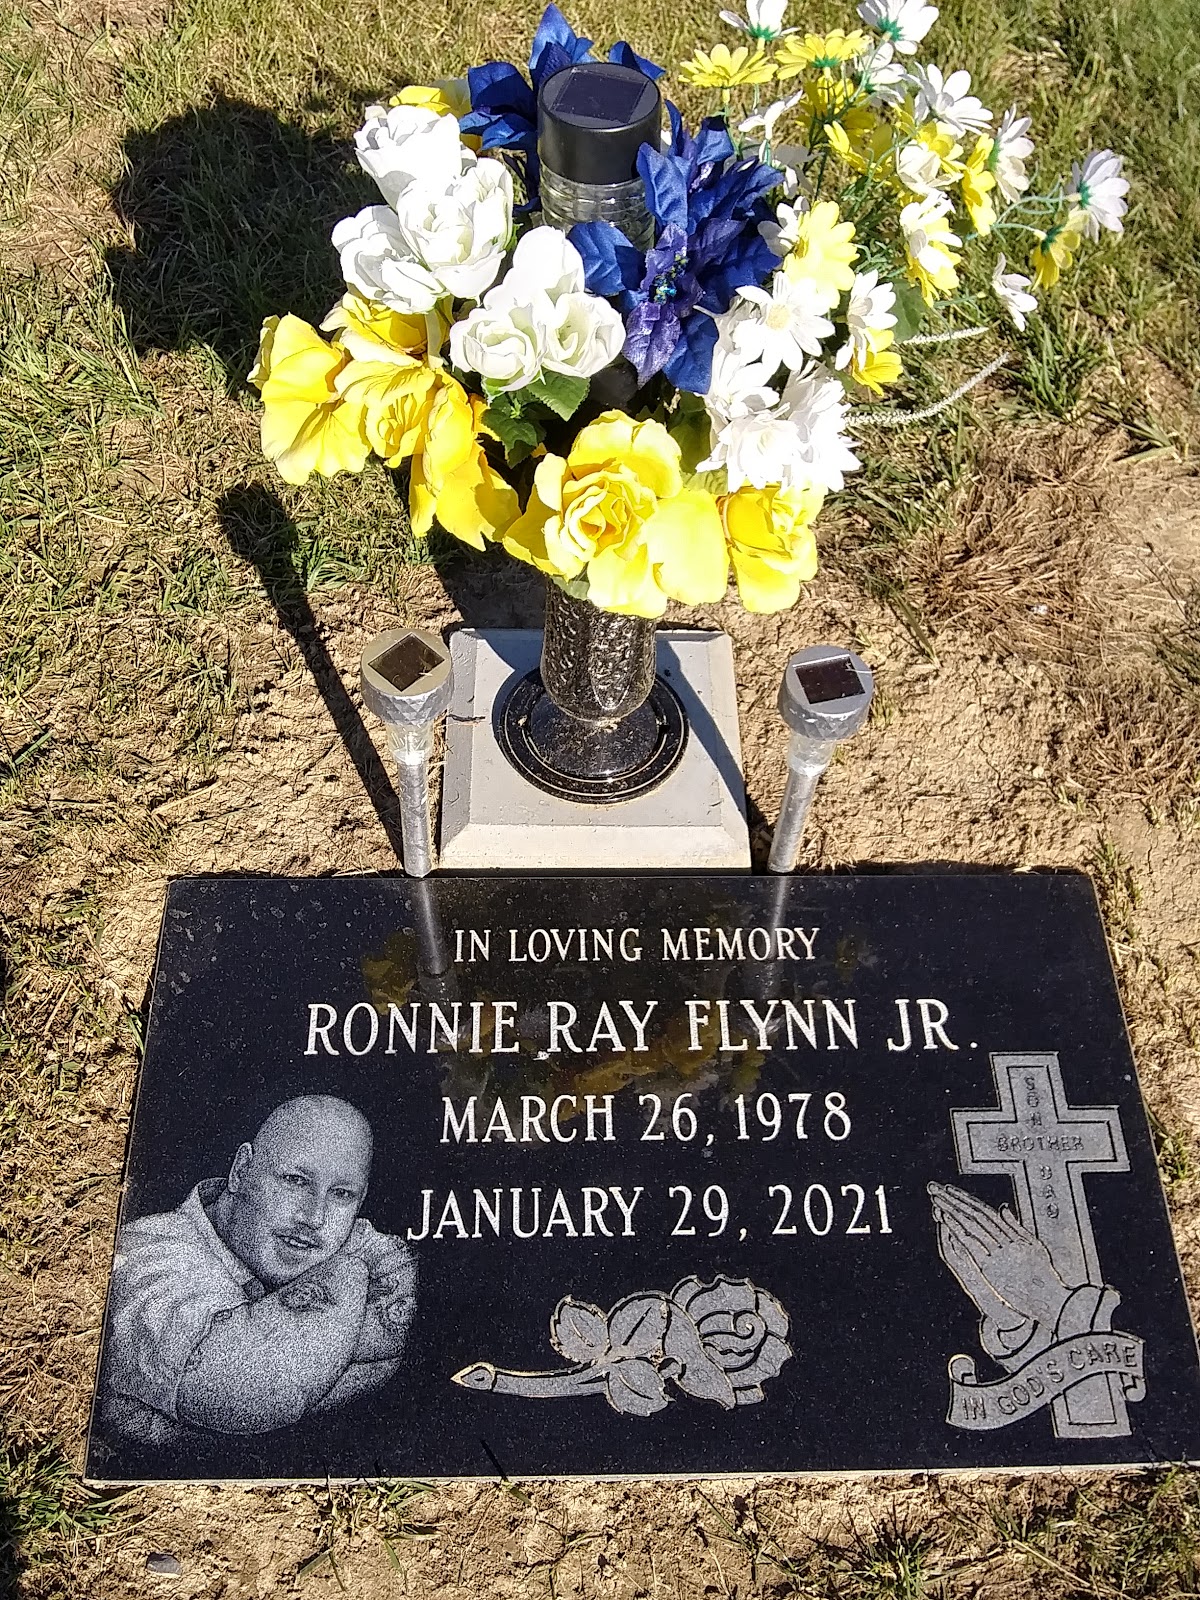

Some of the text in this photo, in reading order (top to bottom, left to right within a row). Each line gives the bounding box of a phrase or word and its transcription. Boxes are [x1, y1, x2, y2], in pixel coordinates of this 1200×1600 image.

[453, 927, 820, 962] IN LOVING MEMORY
[303, 998, 978, 1056] RONNIE RAY FLYNN JR.
[440, 1091, 852, 1147] MARCH 26, 1978
[997, 1135, 1084, 1152] BROTHER
[406, 1183, 894, 1242] JANUARY 29, 2021
[1040, 1165, 1059, 1219] DAD
[961, 1341, 1137, 1421] IN GOD'S CARE
